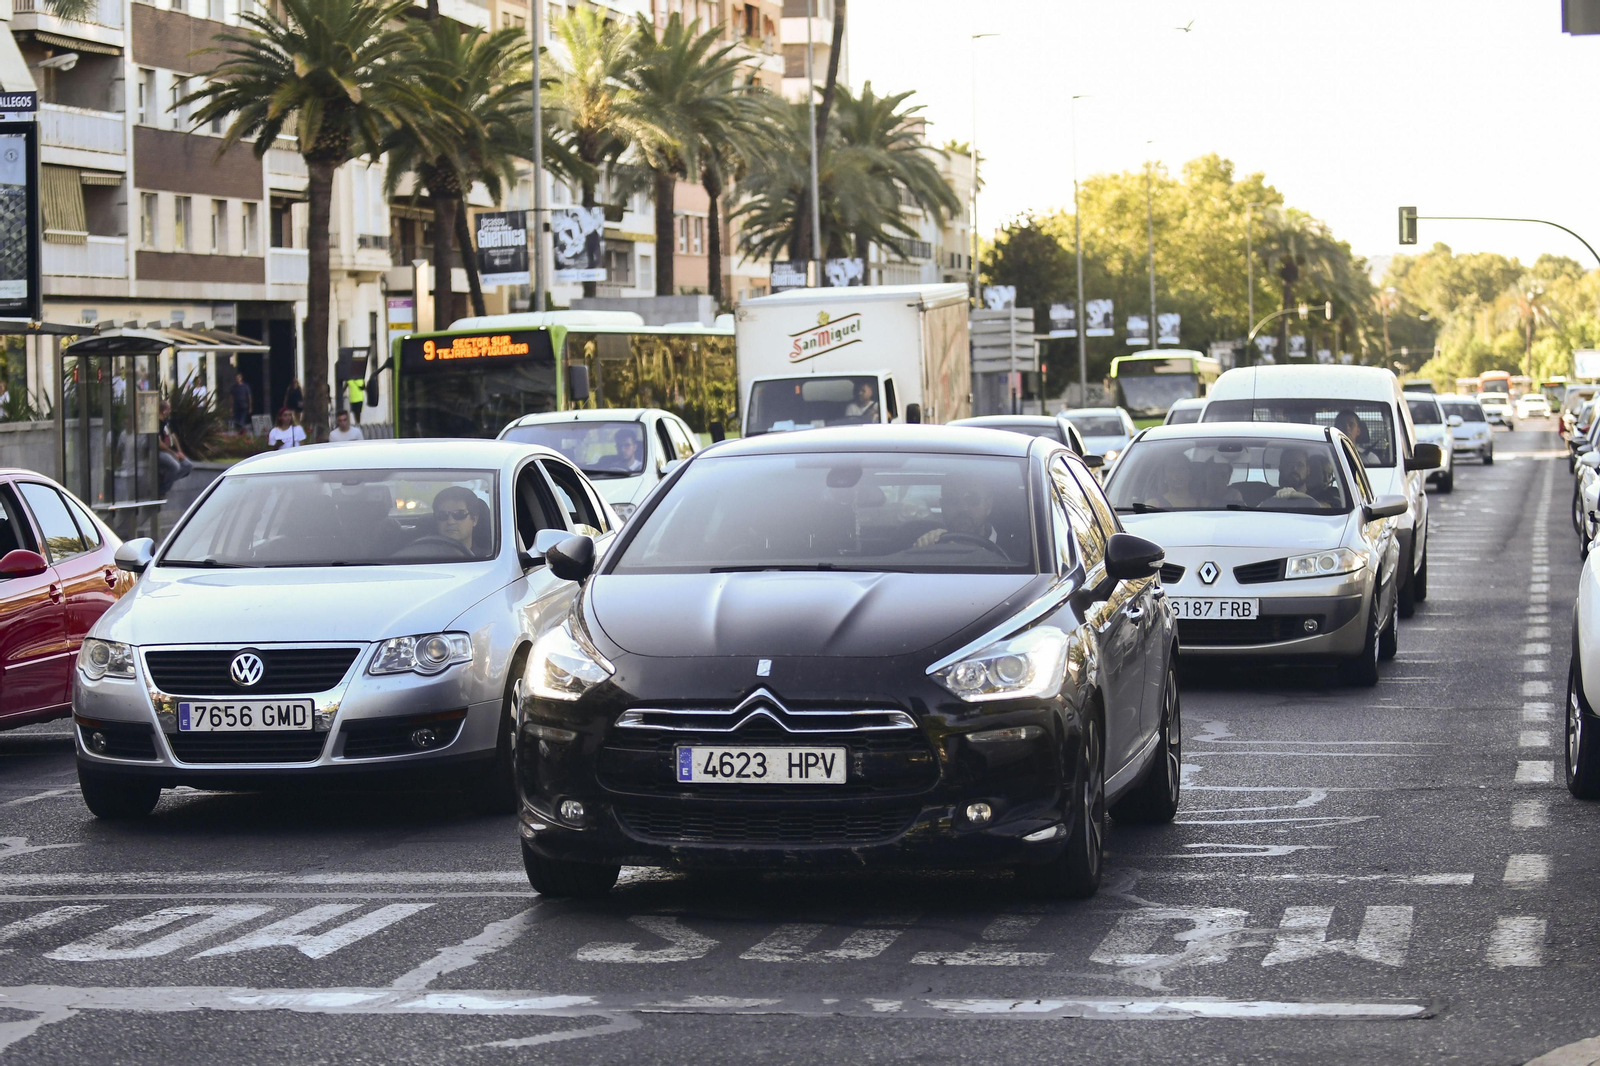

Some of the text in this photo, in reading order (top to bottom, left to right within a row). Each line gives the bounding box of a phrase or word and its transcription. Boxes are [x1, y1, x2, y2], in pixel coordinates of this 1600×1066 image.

[477, 229, 526, 248] Guernica
[423, 340, 435, 360] 9
[436, 343, 529, 360] TEJARES-FIGUEROA
[452, 335, 512, 349] SECTOR SUR
[1171, 601, 1252, 617] 6187 FRB
[230, 653, 264, 686] VW
[194, 705, 306, 728] 7656 GMD
[682, 767, 689, 776] E
[703, 752, 836, 779] 4623 HPV
